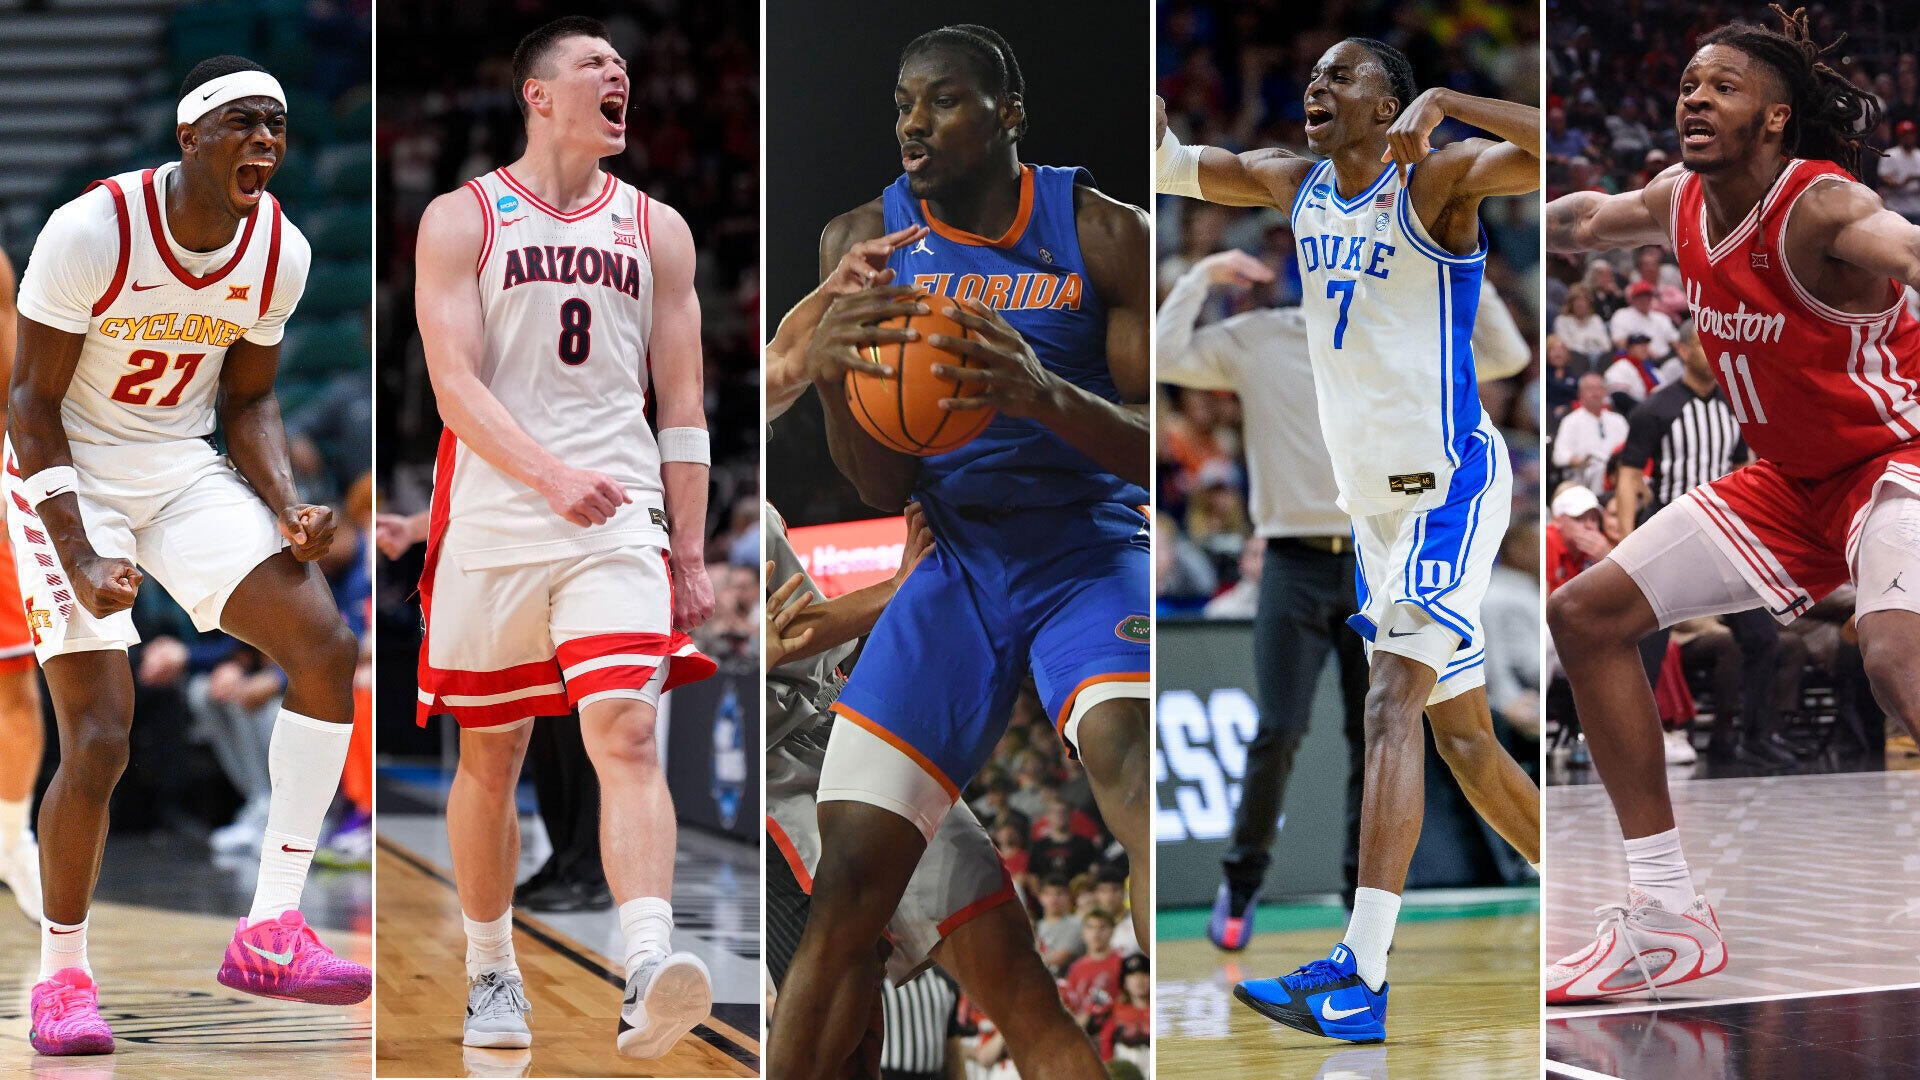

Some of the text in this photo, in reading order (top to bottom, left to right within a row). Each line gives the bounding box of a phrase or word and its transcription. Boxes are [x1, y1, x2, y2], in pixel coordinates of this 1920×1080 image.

[502, 245, 640, 301] ARIZONA
[1300, 235, 1396, 280] DUKE
[913, 273, 1083, 311] FLORIDA
[1326, 279, 1357, 350] 7
[1686, 276, 1786, 344] Houston
[558, 297, 592, 366] 8
[110, 349, 207, 407] 27
[1719, 351, 1769, 424] 11
[1418, 559, 1452, 588] D
[1156, 682, 1286, 841] SS
[1330, 946, 1348, 964] D
